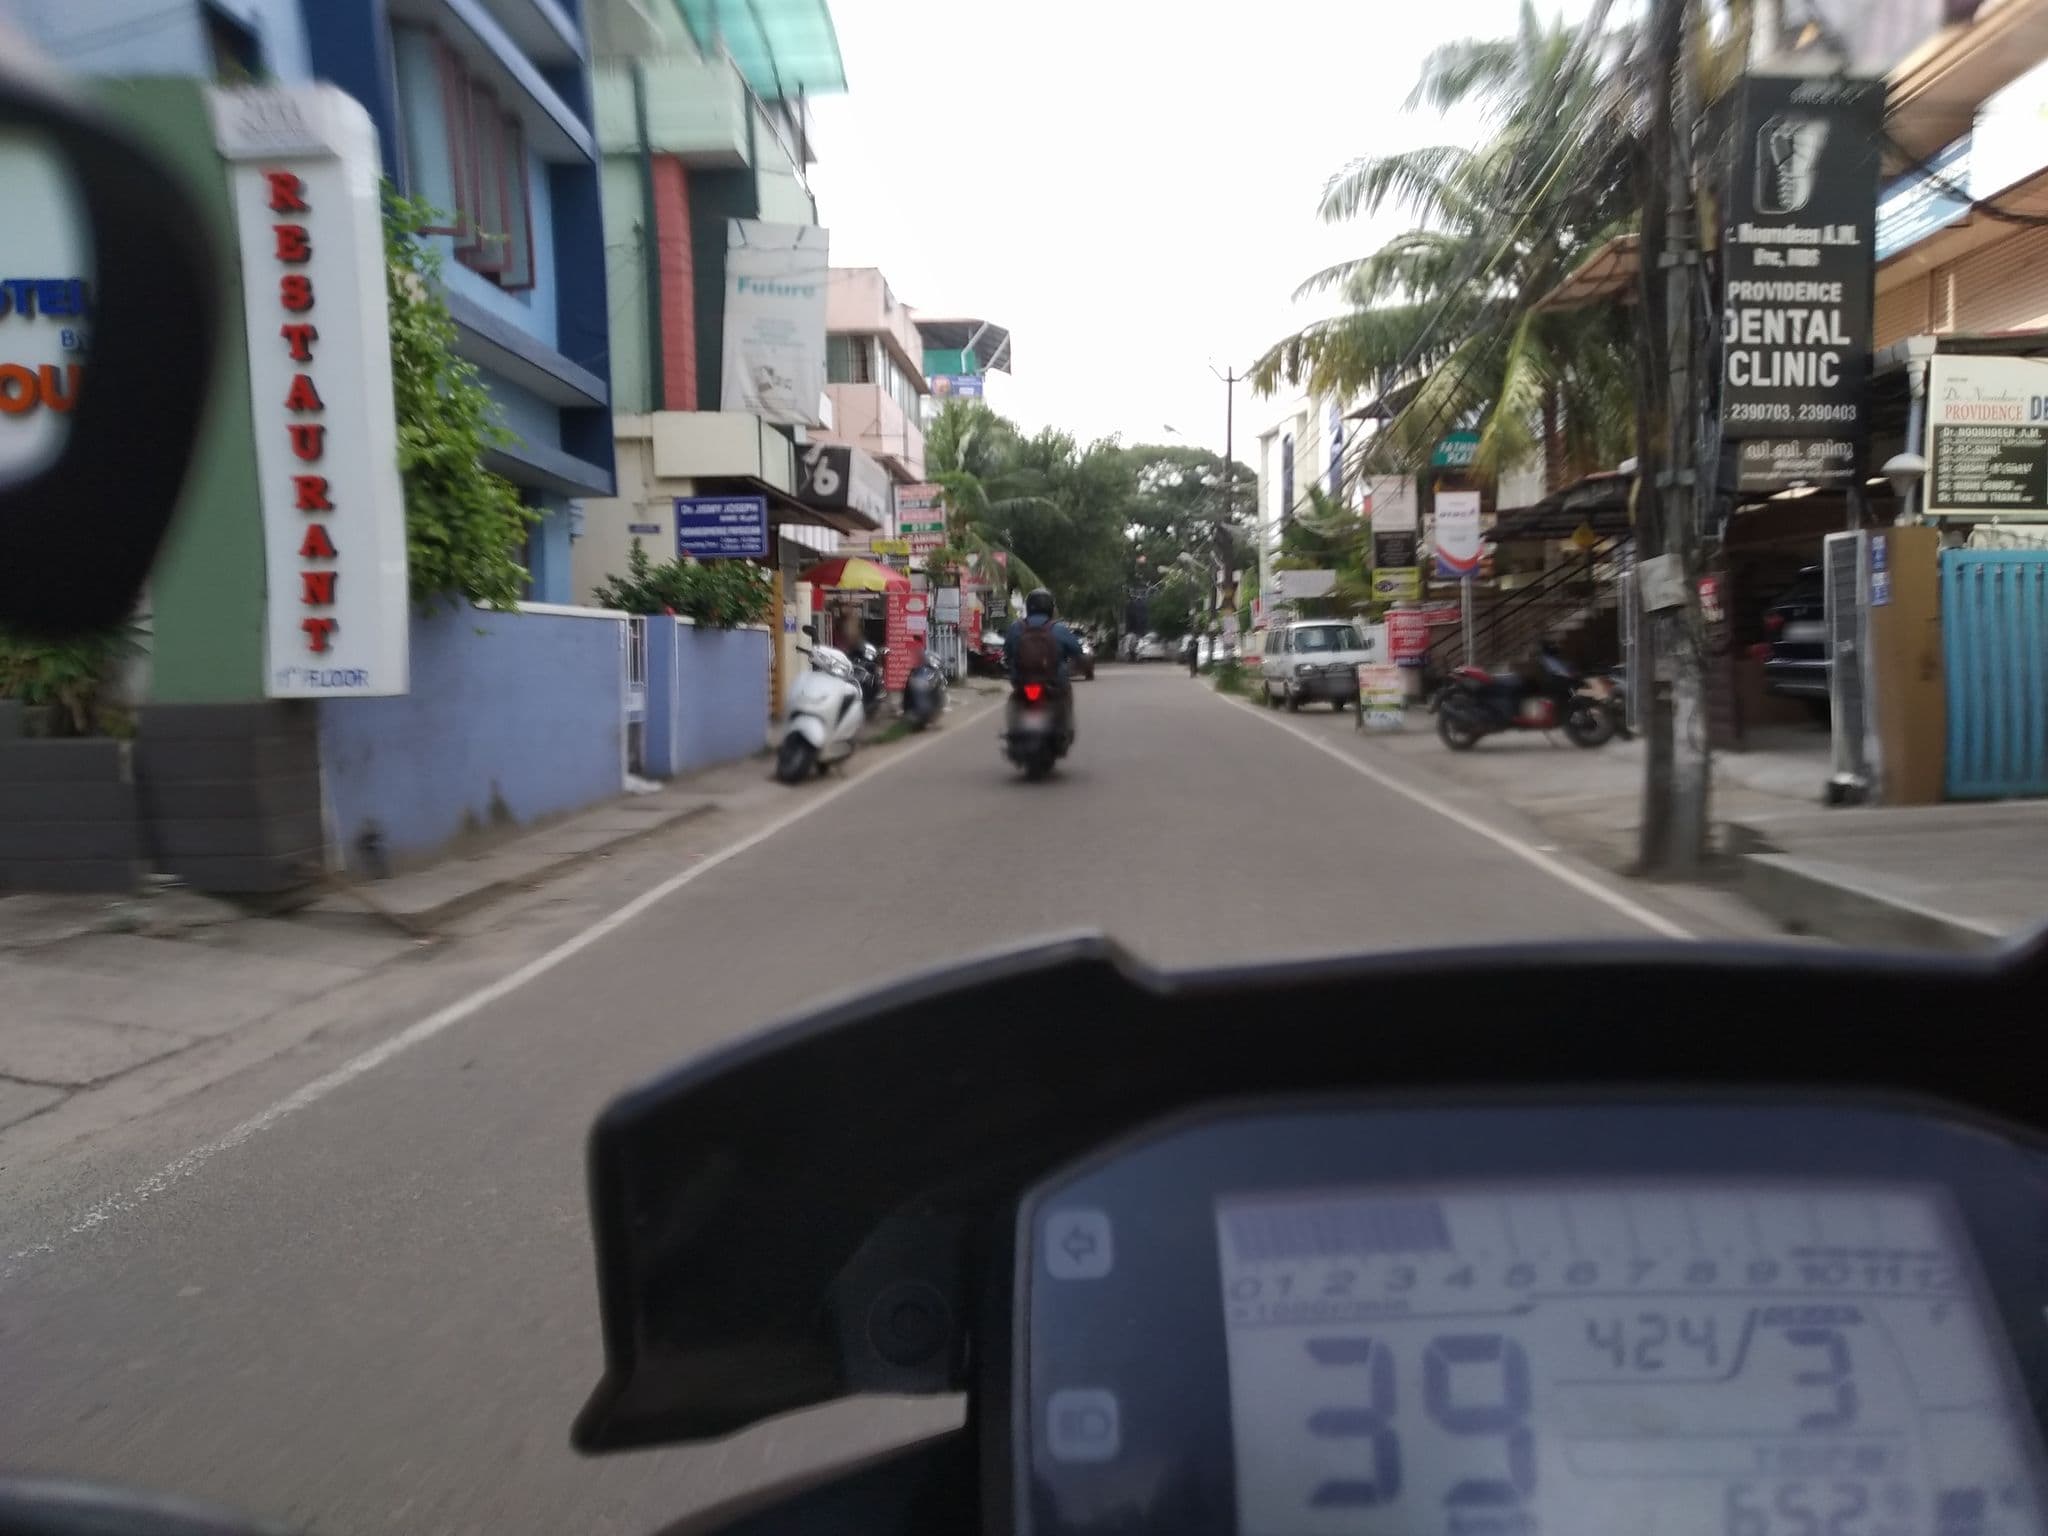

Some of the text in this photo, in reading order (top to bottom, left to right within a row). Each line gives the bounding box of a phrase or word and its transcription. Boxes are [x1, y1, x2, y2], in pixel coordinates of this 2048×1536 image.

[1727, 280, 1842, 303] PROVIDENCE
[1724, 307, 1851, 346] DENTAL
[1728, 350, 1840, 388] CLINIC
[262, 171, 338, 654] RESTAURANT
[1799, 404, 1857, 422] 2390403
[1944, 403, 2023, 422] PROVIDENCE
[1586, 1312, 1718, 1371] 424
[1784, 1328, 1858, 1430] 3
[1305, 1333, 1538, 1508] 39
